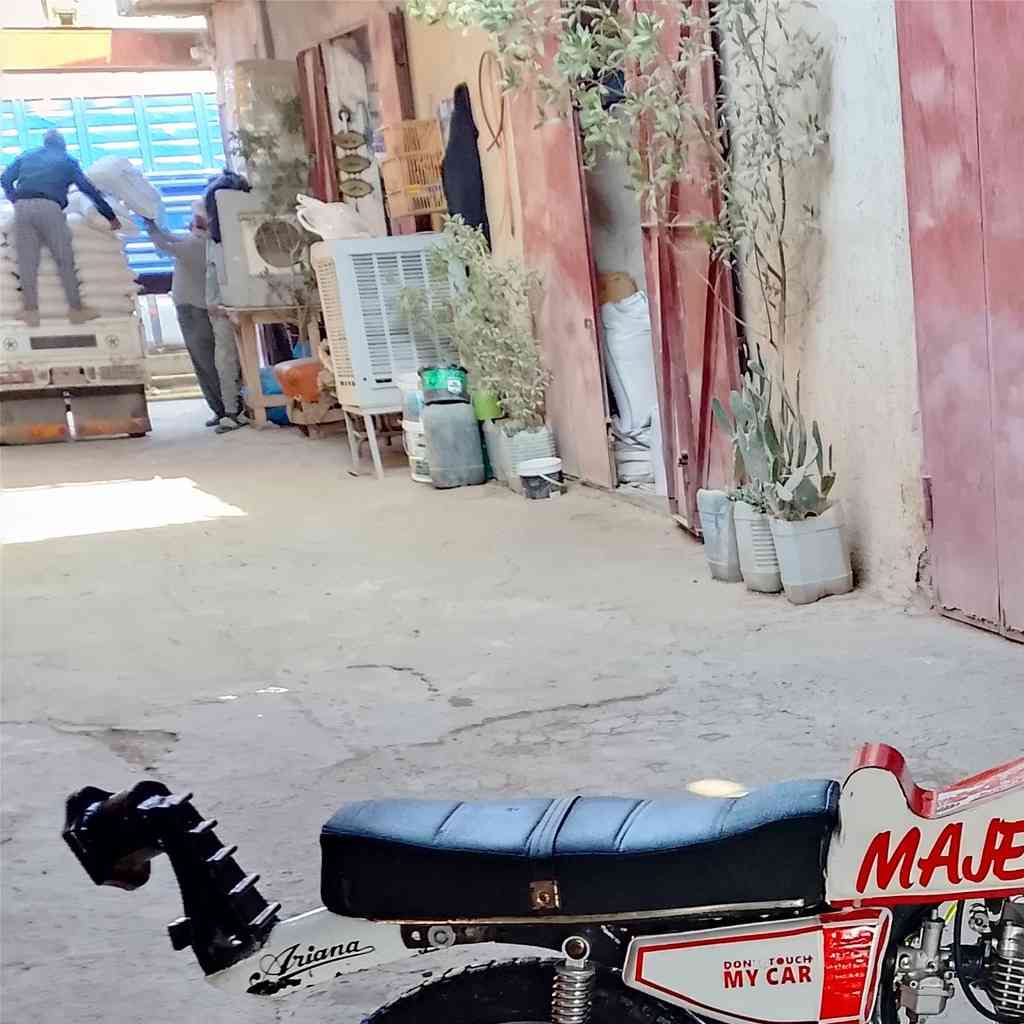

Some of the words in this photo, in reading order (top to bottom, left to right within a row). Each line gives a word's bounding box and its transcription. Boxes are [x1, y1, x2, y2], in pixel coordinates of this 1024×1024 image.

[257, 940, 375, 978] Ariana
[769, 954, 813, 966] TOUCH
[723, 969, 758, 988] MY
[766, 965, 812, 985] CAR
